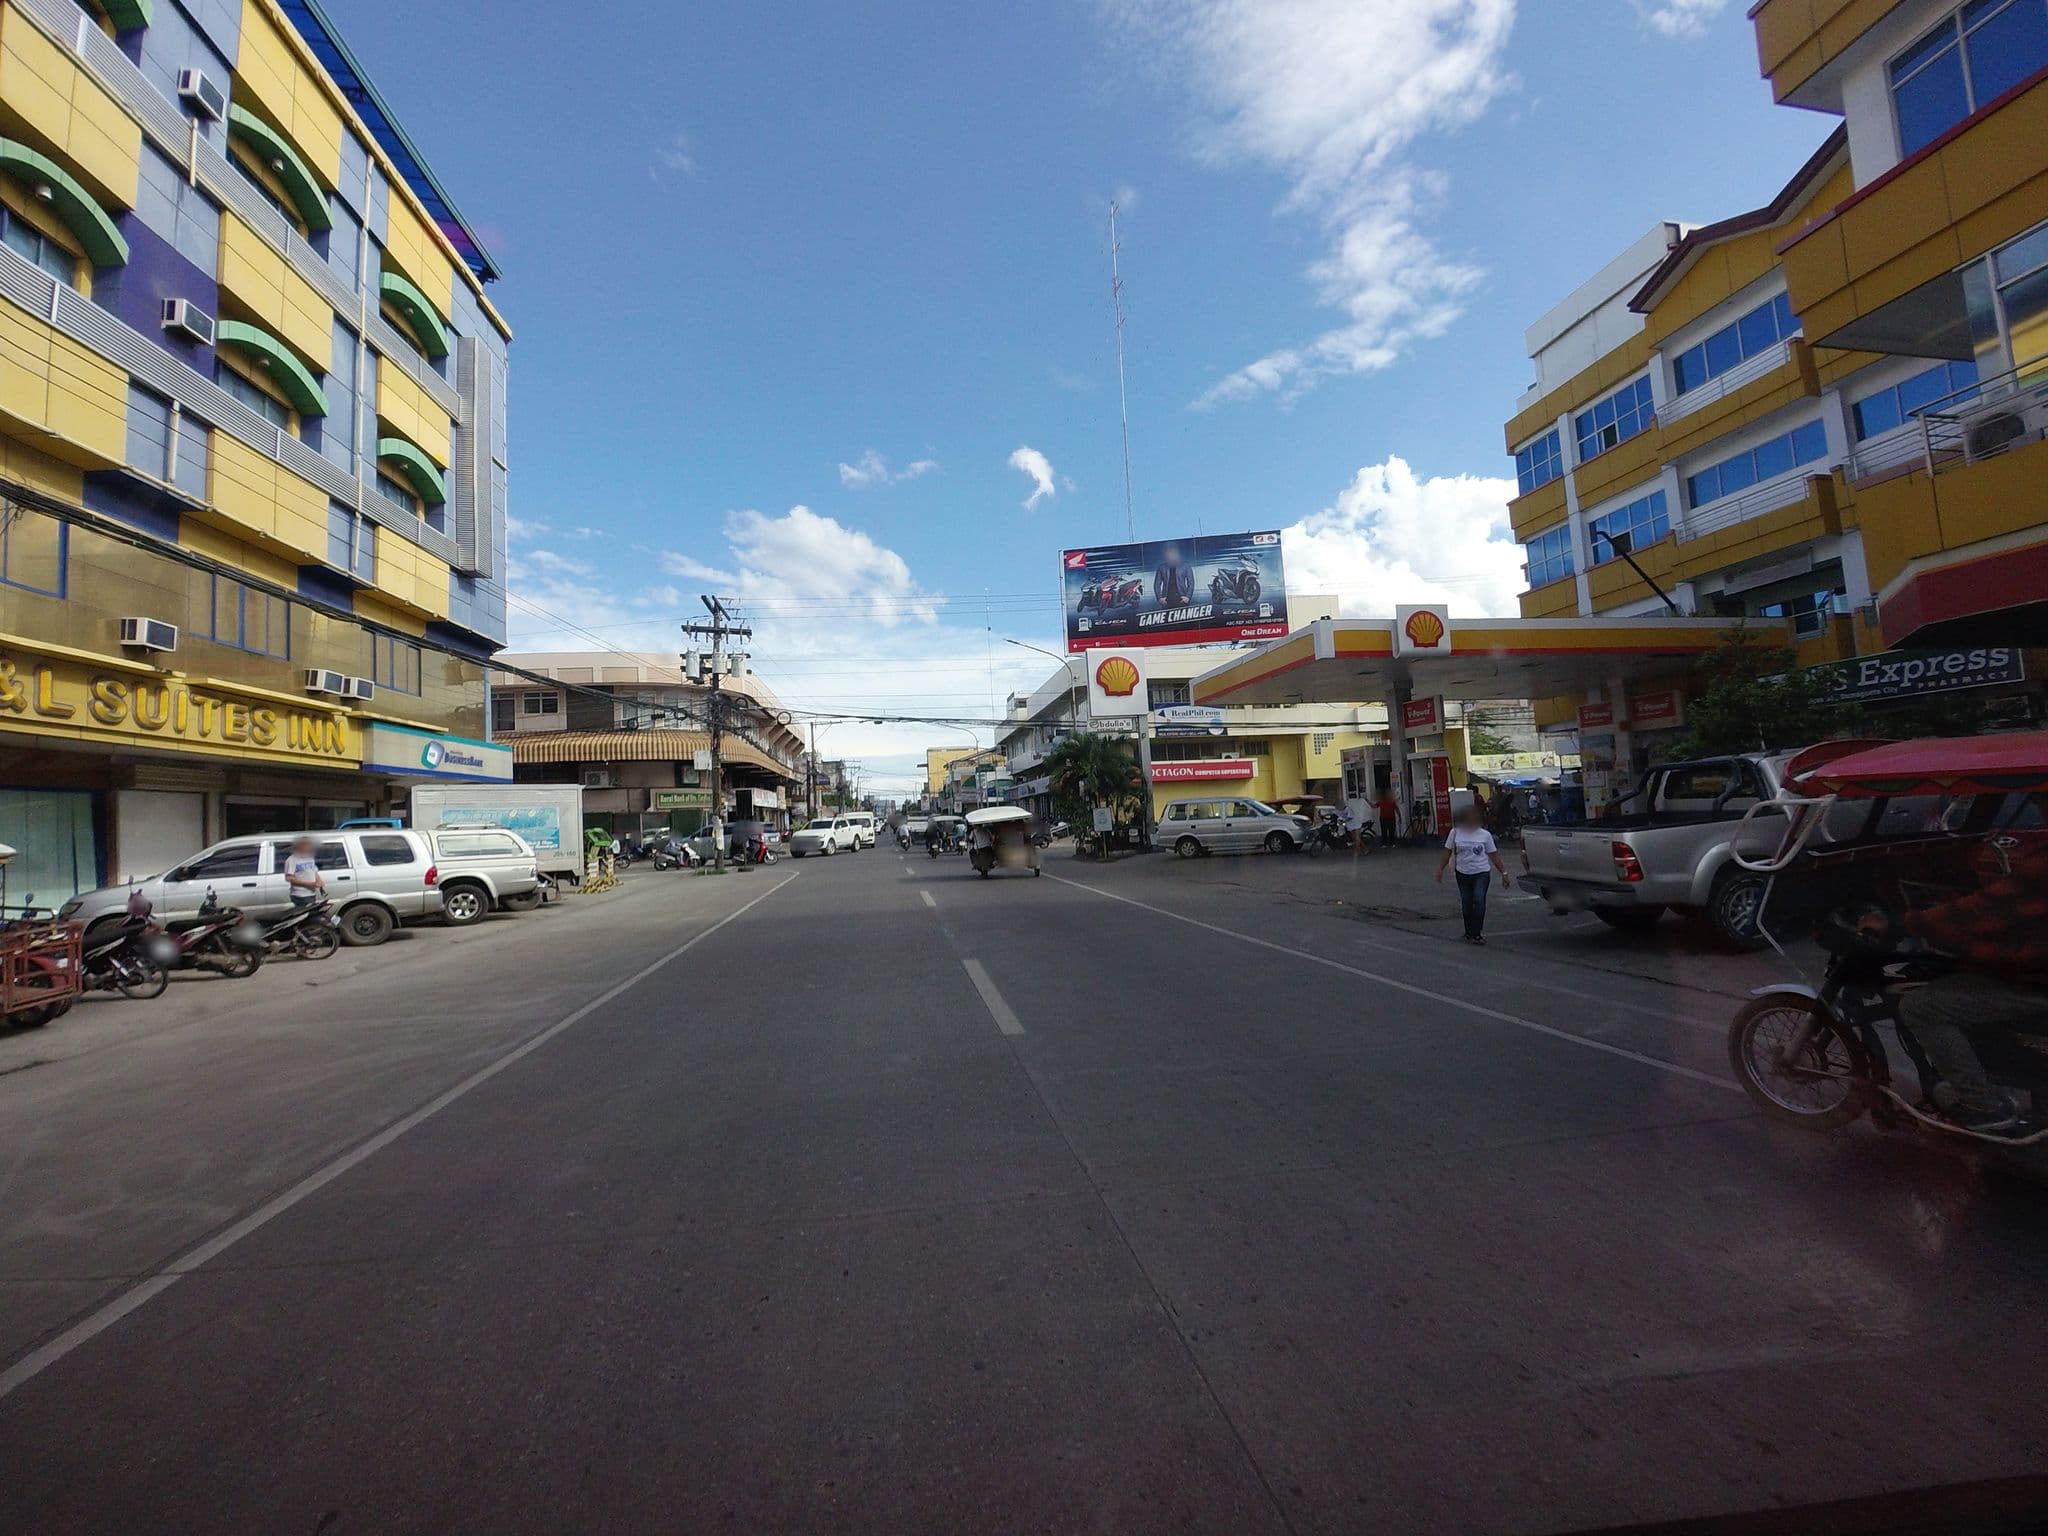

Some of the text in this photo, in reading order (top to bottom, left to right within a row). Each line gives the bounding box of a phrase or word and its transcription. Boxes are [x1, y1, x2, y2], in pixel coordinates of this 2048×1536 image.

[1139, 604, 1212, 627] GAME CHANGER
[1857, 647, 2009, 688] Express
[1917, 671, 2009, 689] PHARMACY
[33, 664, 76, 719] L
[88, 675, 278, 746] SUITES
[287, 710, 345, 755] INN
